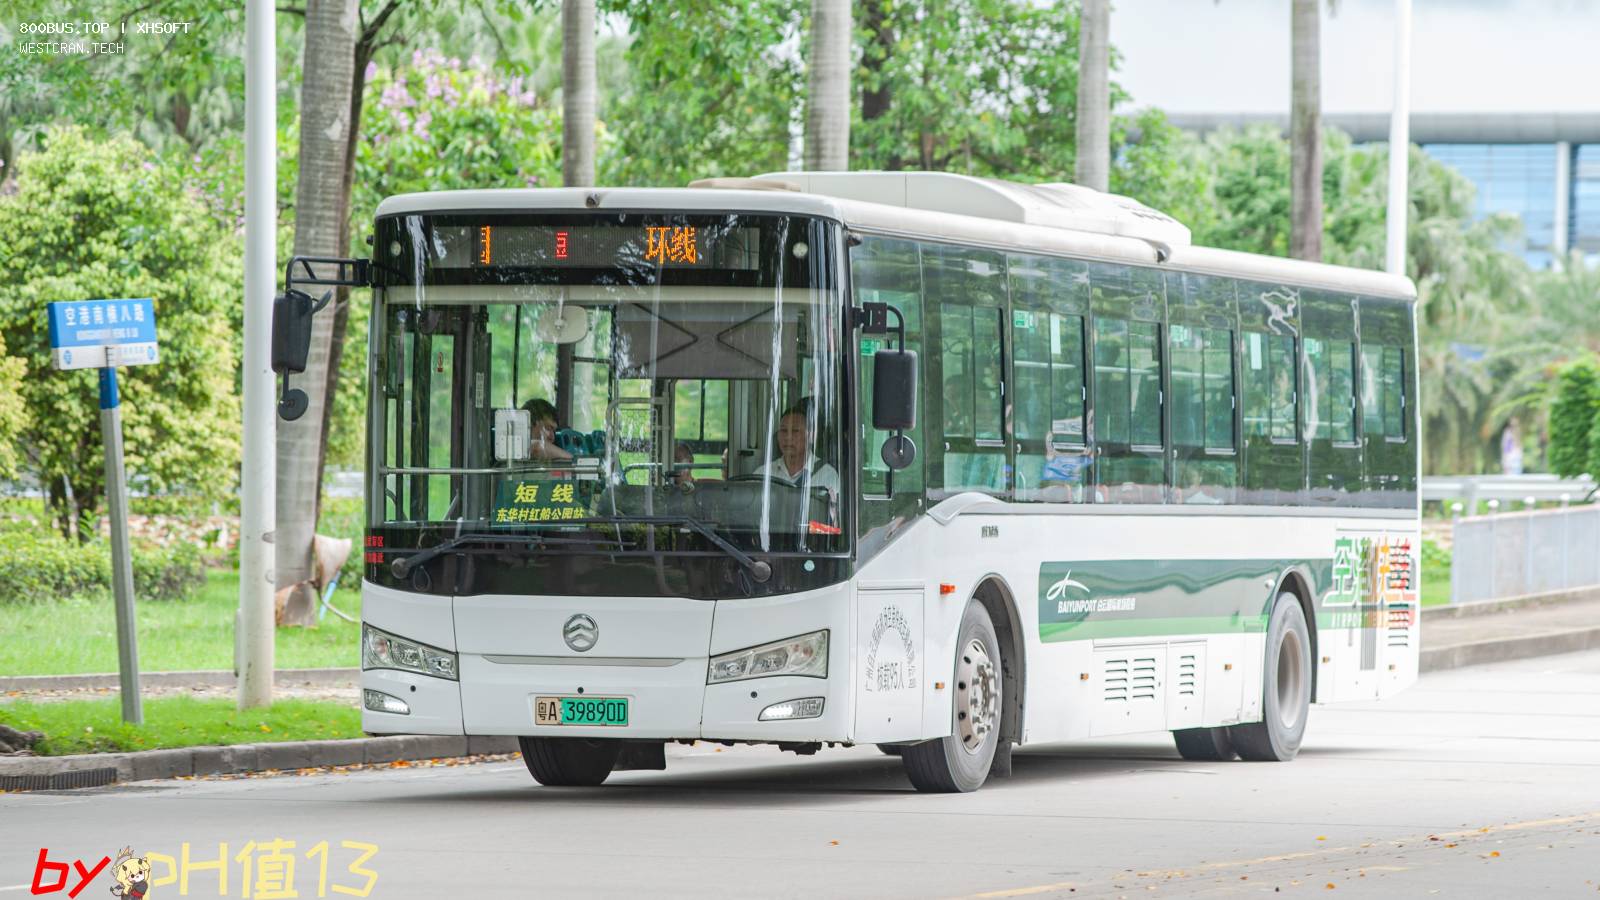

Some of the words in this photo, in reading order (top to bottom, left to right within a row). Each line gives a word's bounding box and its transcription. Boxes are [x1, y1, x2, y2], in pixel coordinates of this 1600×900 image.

[645, 226, 696, 264] 环线
[495, 507, 586, 522] 东华村红船公园站
[1057, 599, 1097, 614] BAIYUNPORT
